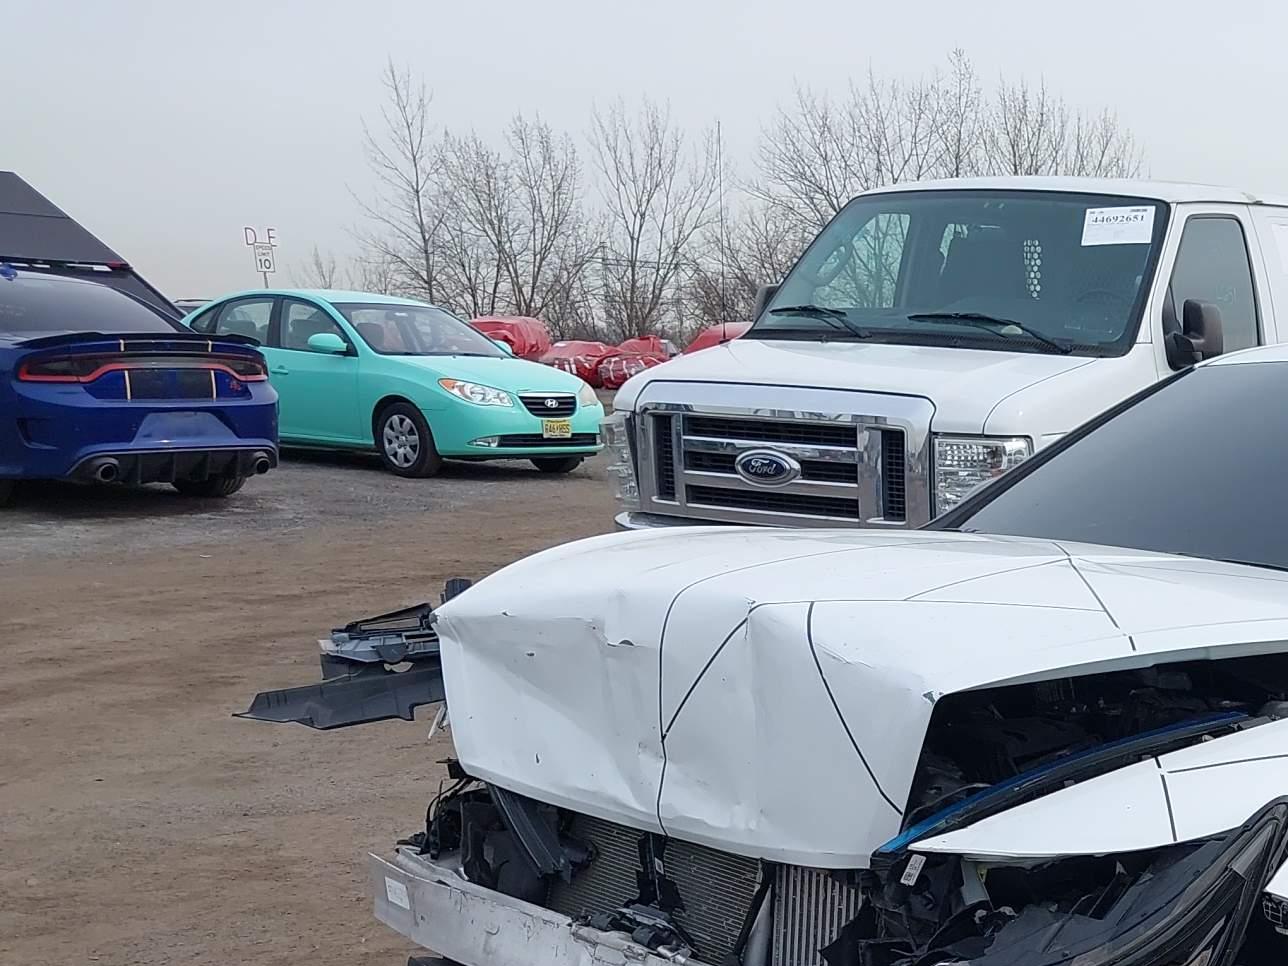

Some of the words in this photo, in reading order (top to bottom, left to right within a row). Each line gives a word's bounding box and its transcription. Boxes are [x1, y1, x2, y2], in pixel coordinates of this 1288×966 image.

[1092, 214, 1145, 224] 44692651
[258, 258, 271, 270] 10
[749, 458, 777, 475] Ford
